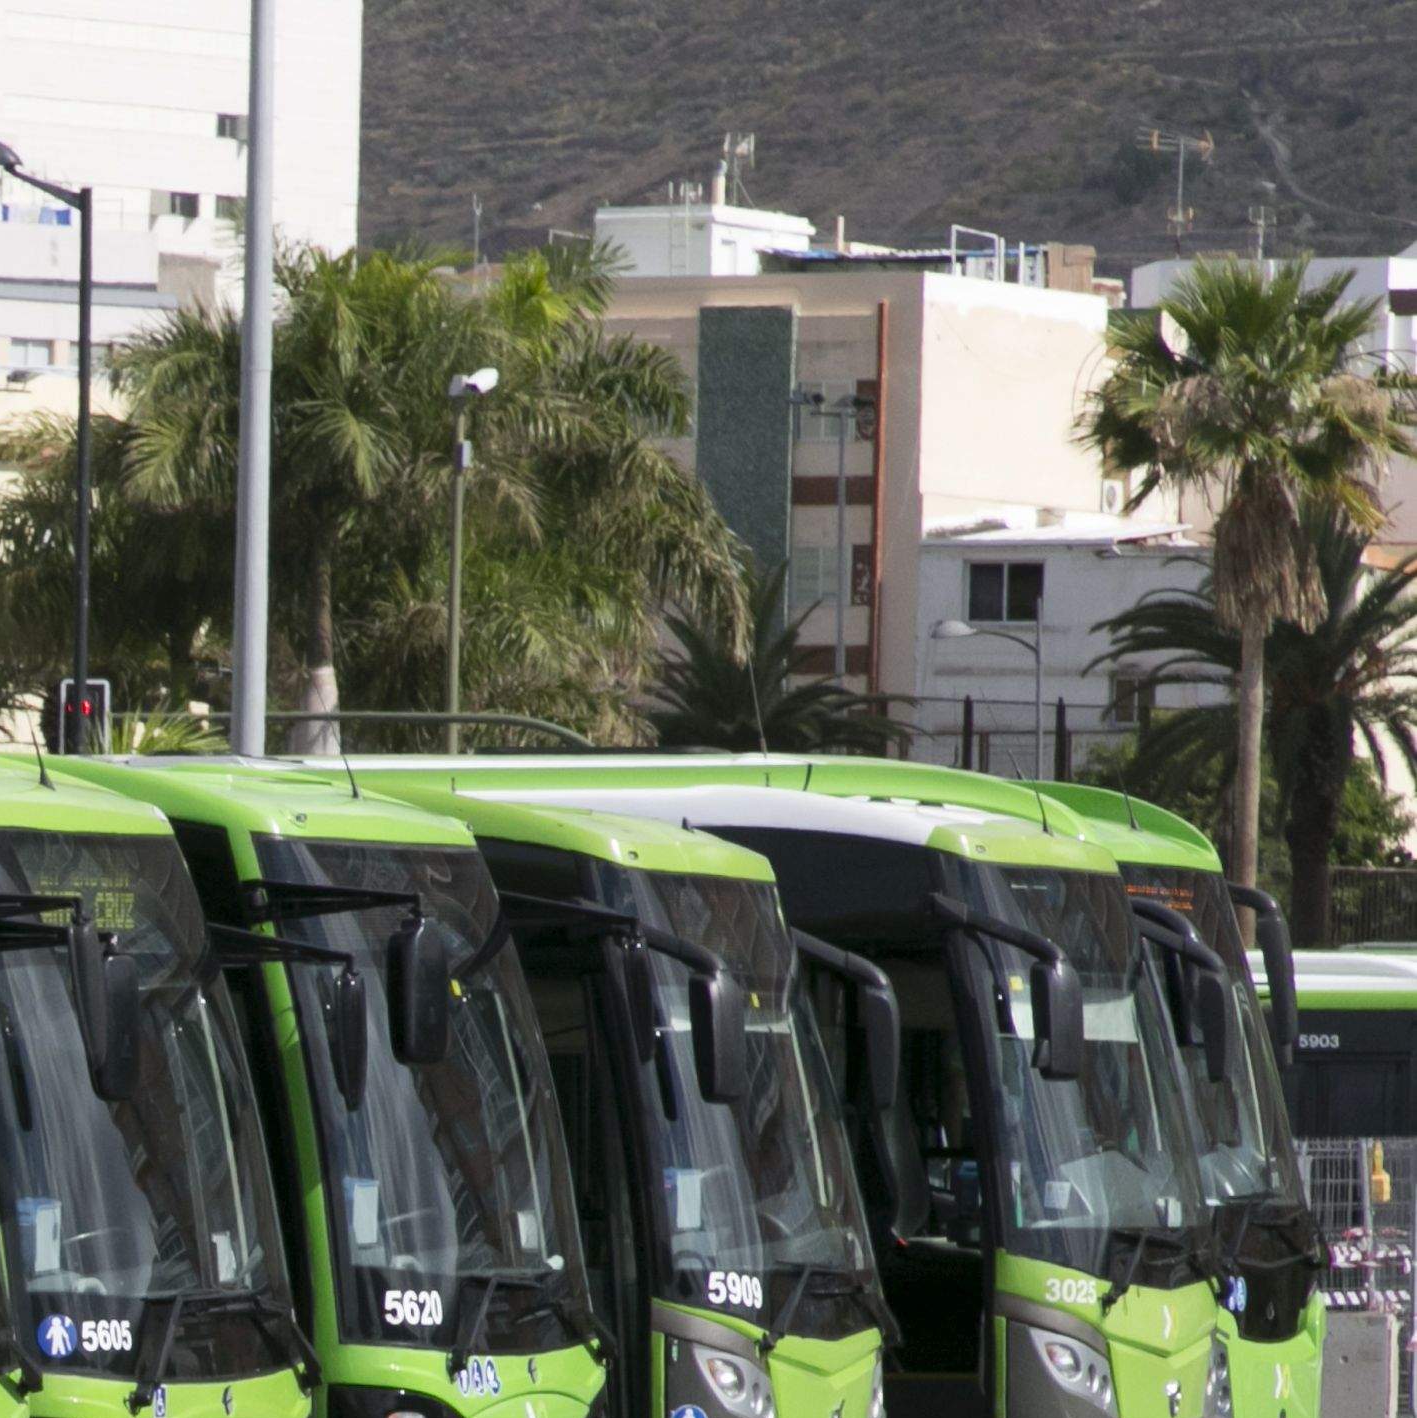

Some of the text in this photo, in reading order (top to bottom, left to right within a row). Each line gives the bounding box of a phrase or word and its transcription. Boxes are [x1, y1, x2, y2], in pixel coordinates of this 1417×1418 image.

[1299, 1034, 1339, 1048] 5903
[708, 1271, 763, 1309] 5909
[1046, 1278, 1097, 1303] 3025
[385, 1290, 443, 1325] 5620
[82, 1319, 132, 1351] 5605
